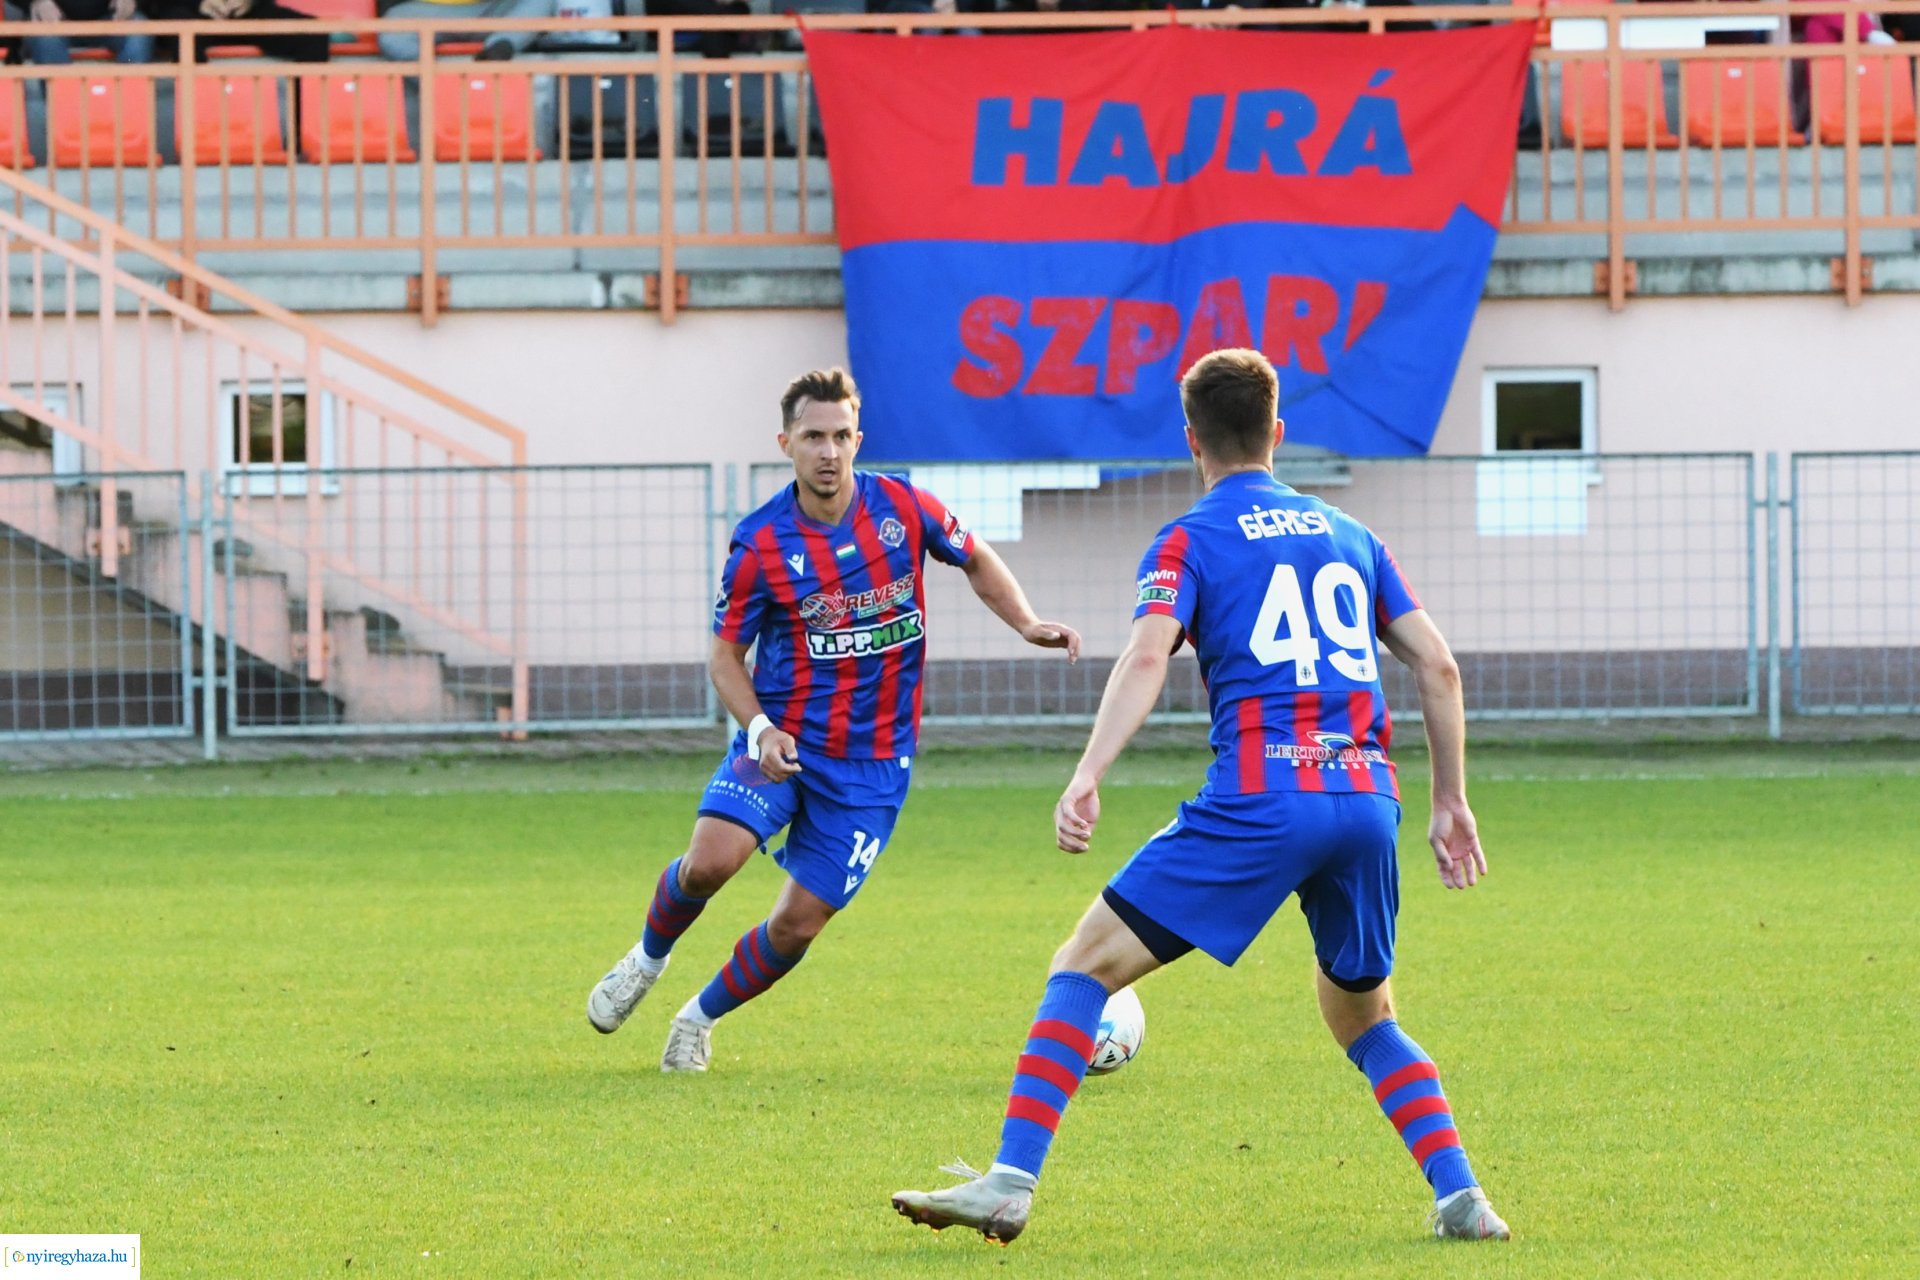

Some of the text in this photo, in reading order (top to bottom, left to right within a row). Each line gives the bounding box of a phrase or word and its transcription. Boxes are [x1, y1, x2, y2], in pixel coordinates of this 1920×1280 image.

[971, 69, 1413, 188] HAJRÁ
[1249, 562, 1378, 686] 49
[847, 830, 880, 873] 14
